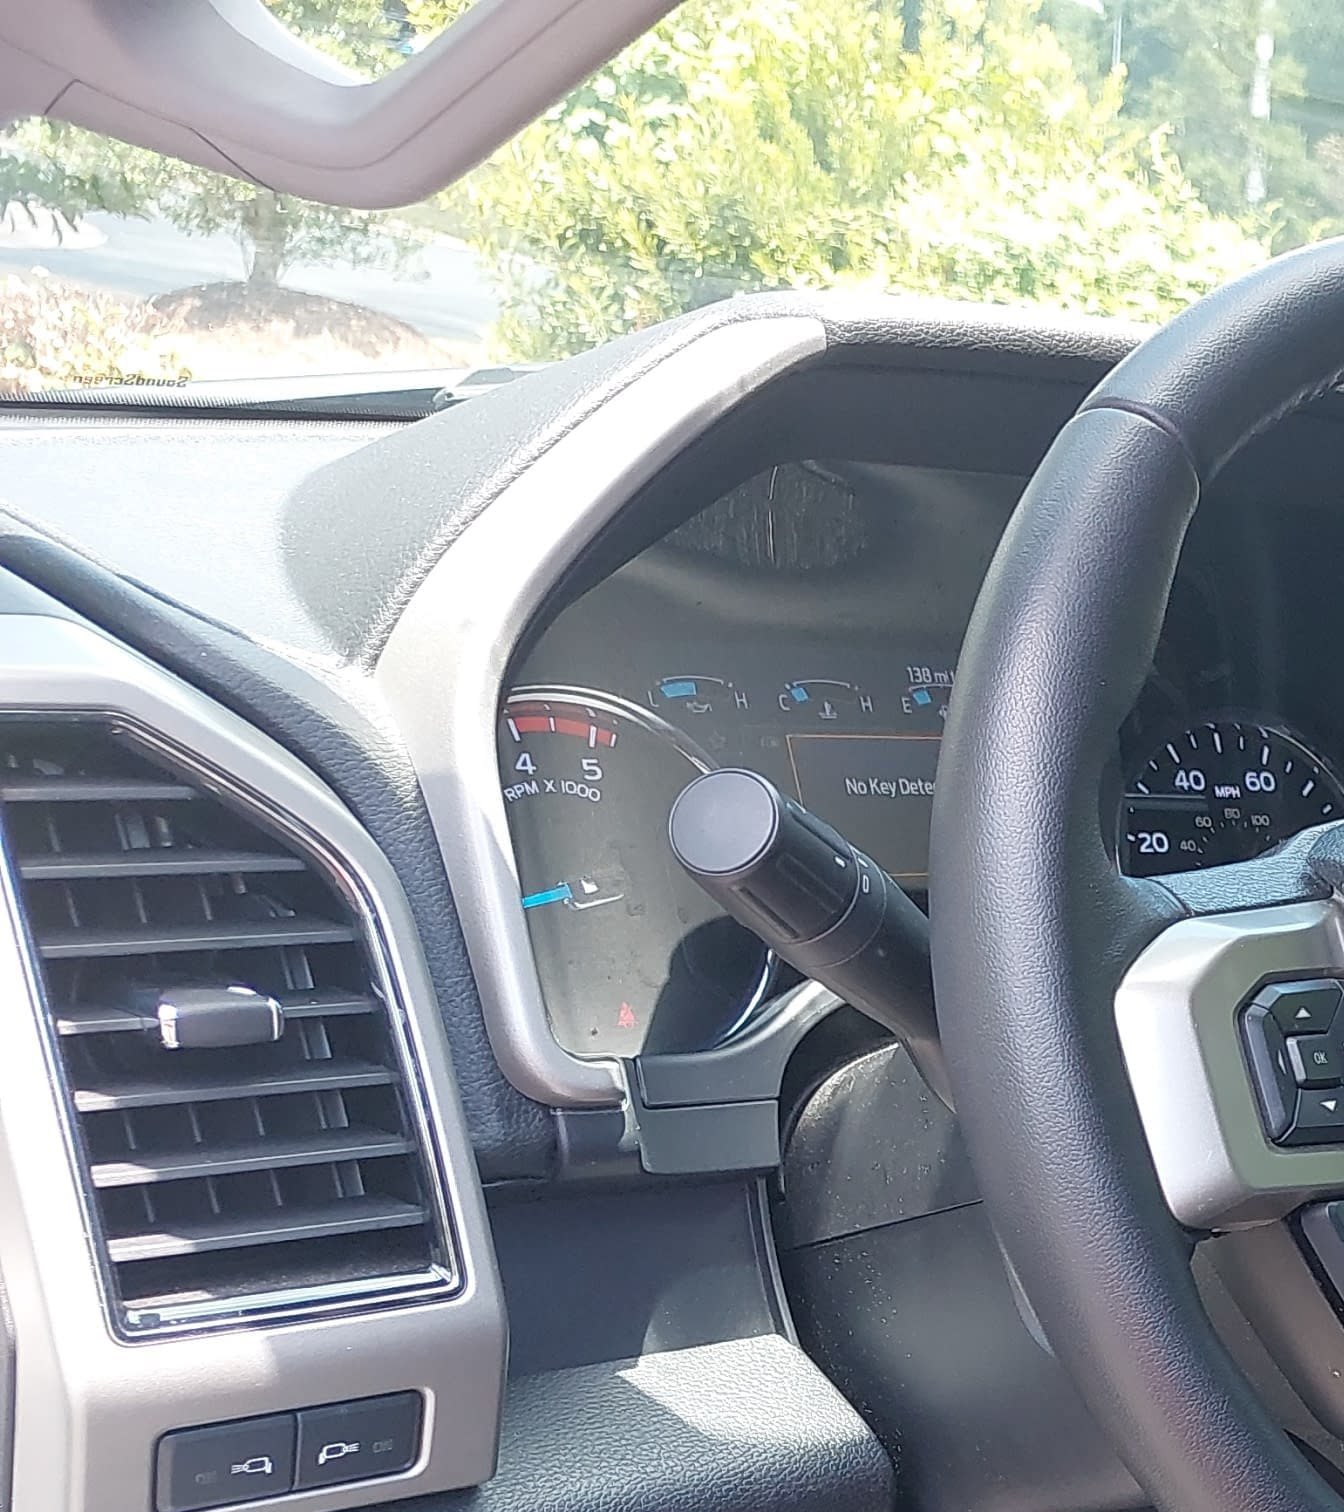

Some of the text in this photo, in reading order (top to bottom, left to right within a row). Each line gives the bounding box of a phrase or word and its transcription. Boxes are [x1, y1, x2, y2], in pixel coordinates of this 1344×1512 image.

[906, 665, 932, 683] 138
[734, 691, 749, 710] H
[778, 693, 792, 712] C
[859, 694, 874, 713] H
[901, 697, 913, 714] E
[514, 752, 537, 775] 4
[582, 758, 603, 780] 5
[845, 776, 936, 798] No Key Dete
[1174, 769, 1206, 792] 40
[1244, 771, 1276, 792] 60
[504, 780, 540, 802] RPM
[561, 779, 602, 802] 1000
[1214, 785, 1241, 799] MPH
[1195, 816, 1213, 828] 60
[1251, 815, 1270, 827] 100
[1137, 831, 1169, 853] 20
[1179, 839, 1197, 852] 40
[1313, 1051, 1328, 1065] OK
